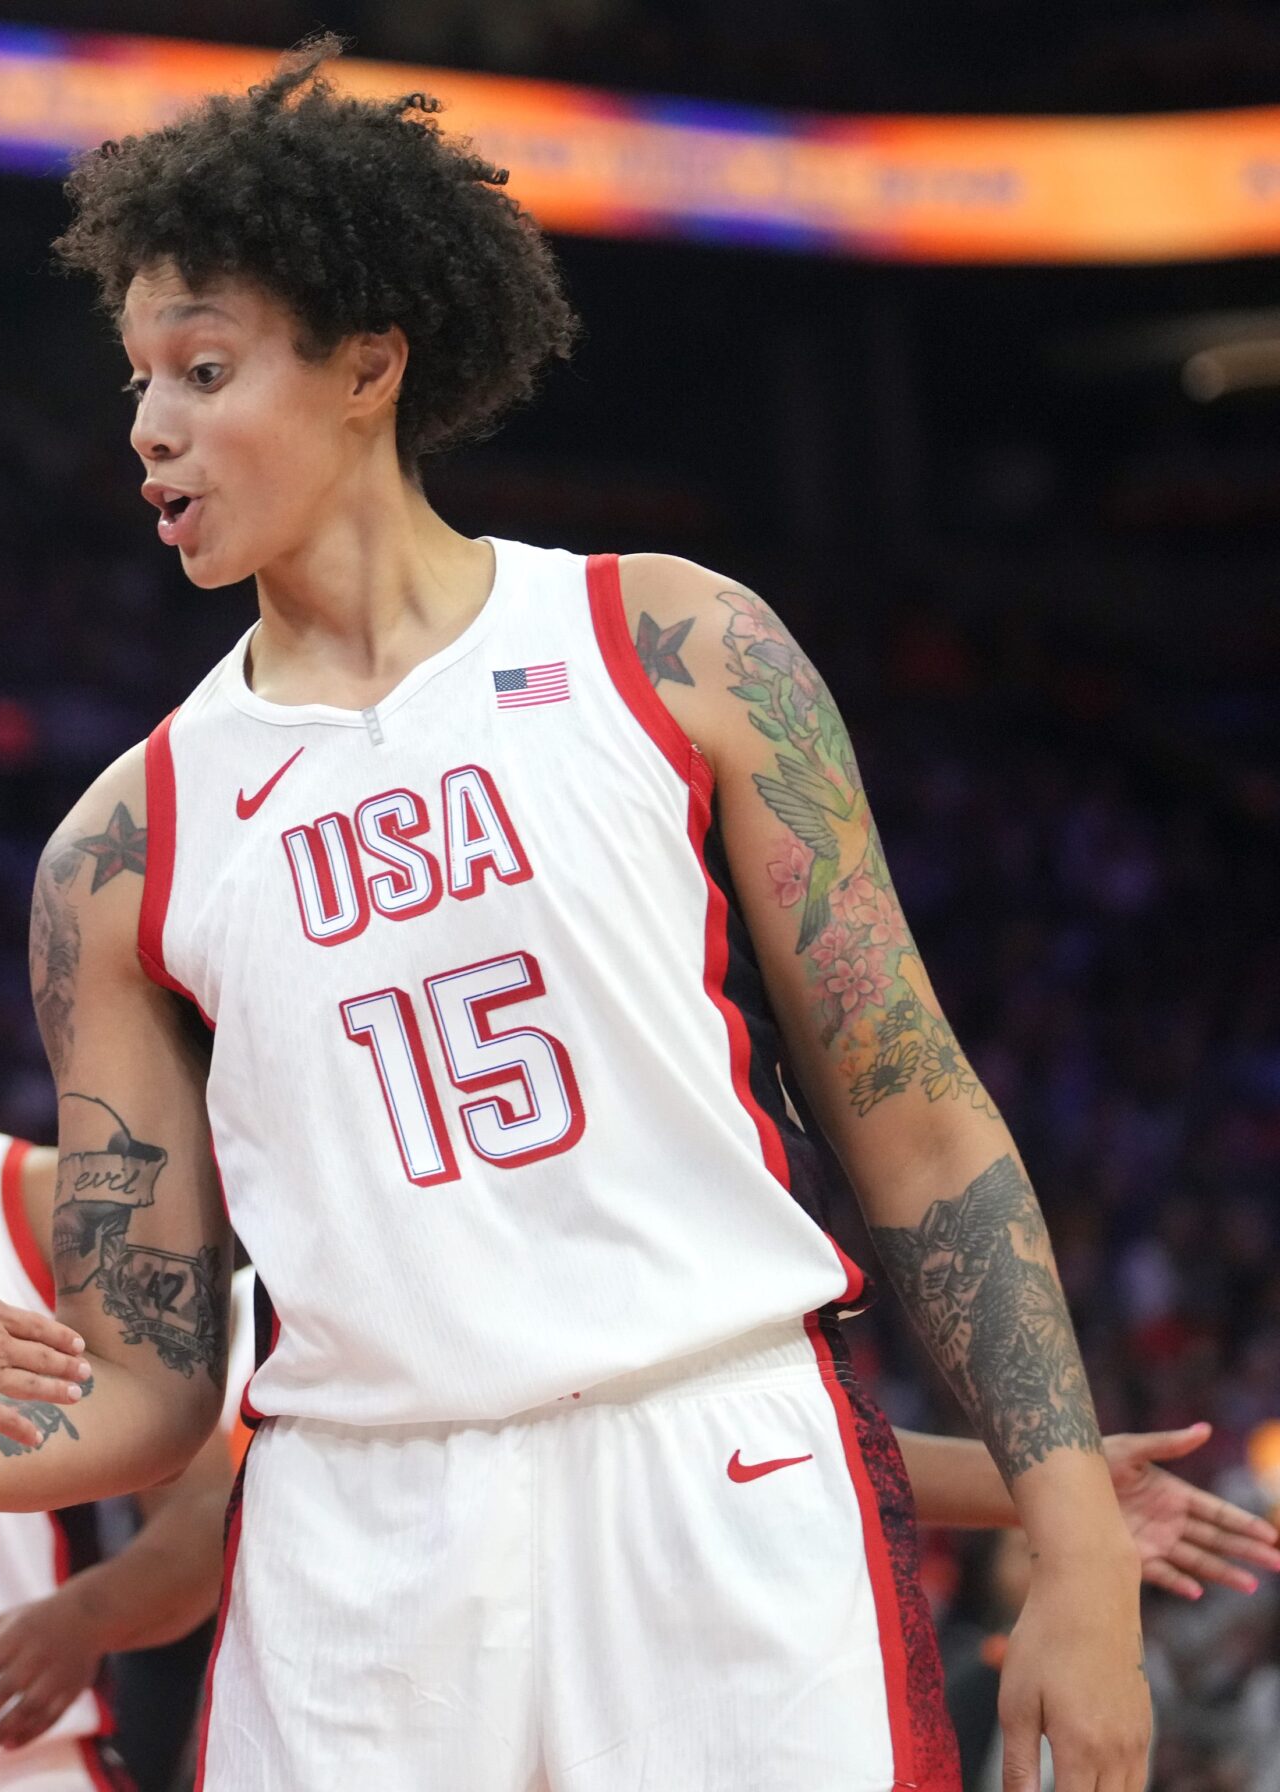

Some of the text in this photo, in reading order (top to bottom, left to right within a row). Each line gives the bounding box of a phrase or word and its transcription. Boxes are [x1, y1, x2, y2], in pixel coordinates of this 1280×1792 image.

[282, 764, 534, 947] USA
[339, 951, 586, 1188] 15
[74, 1168, 140, 1195] evil
